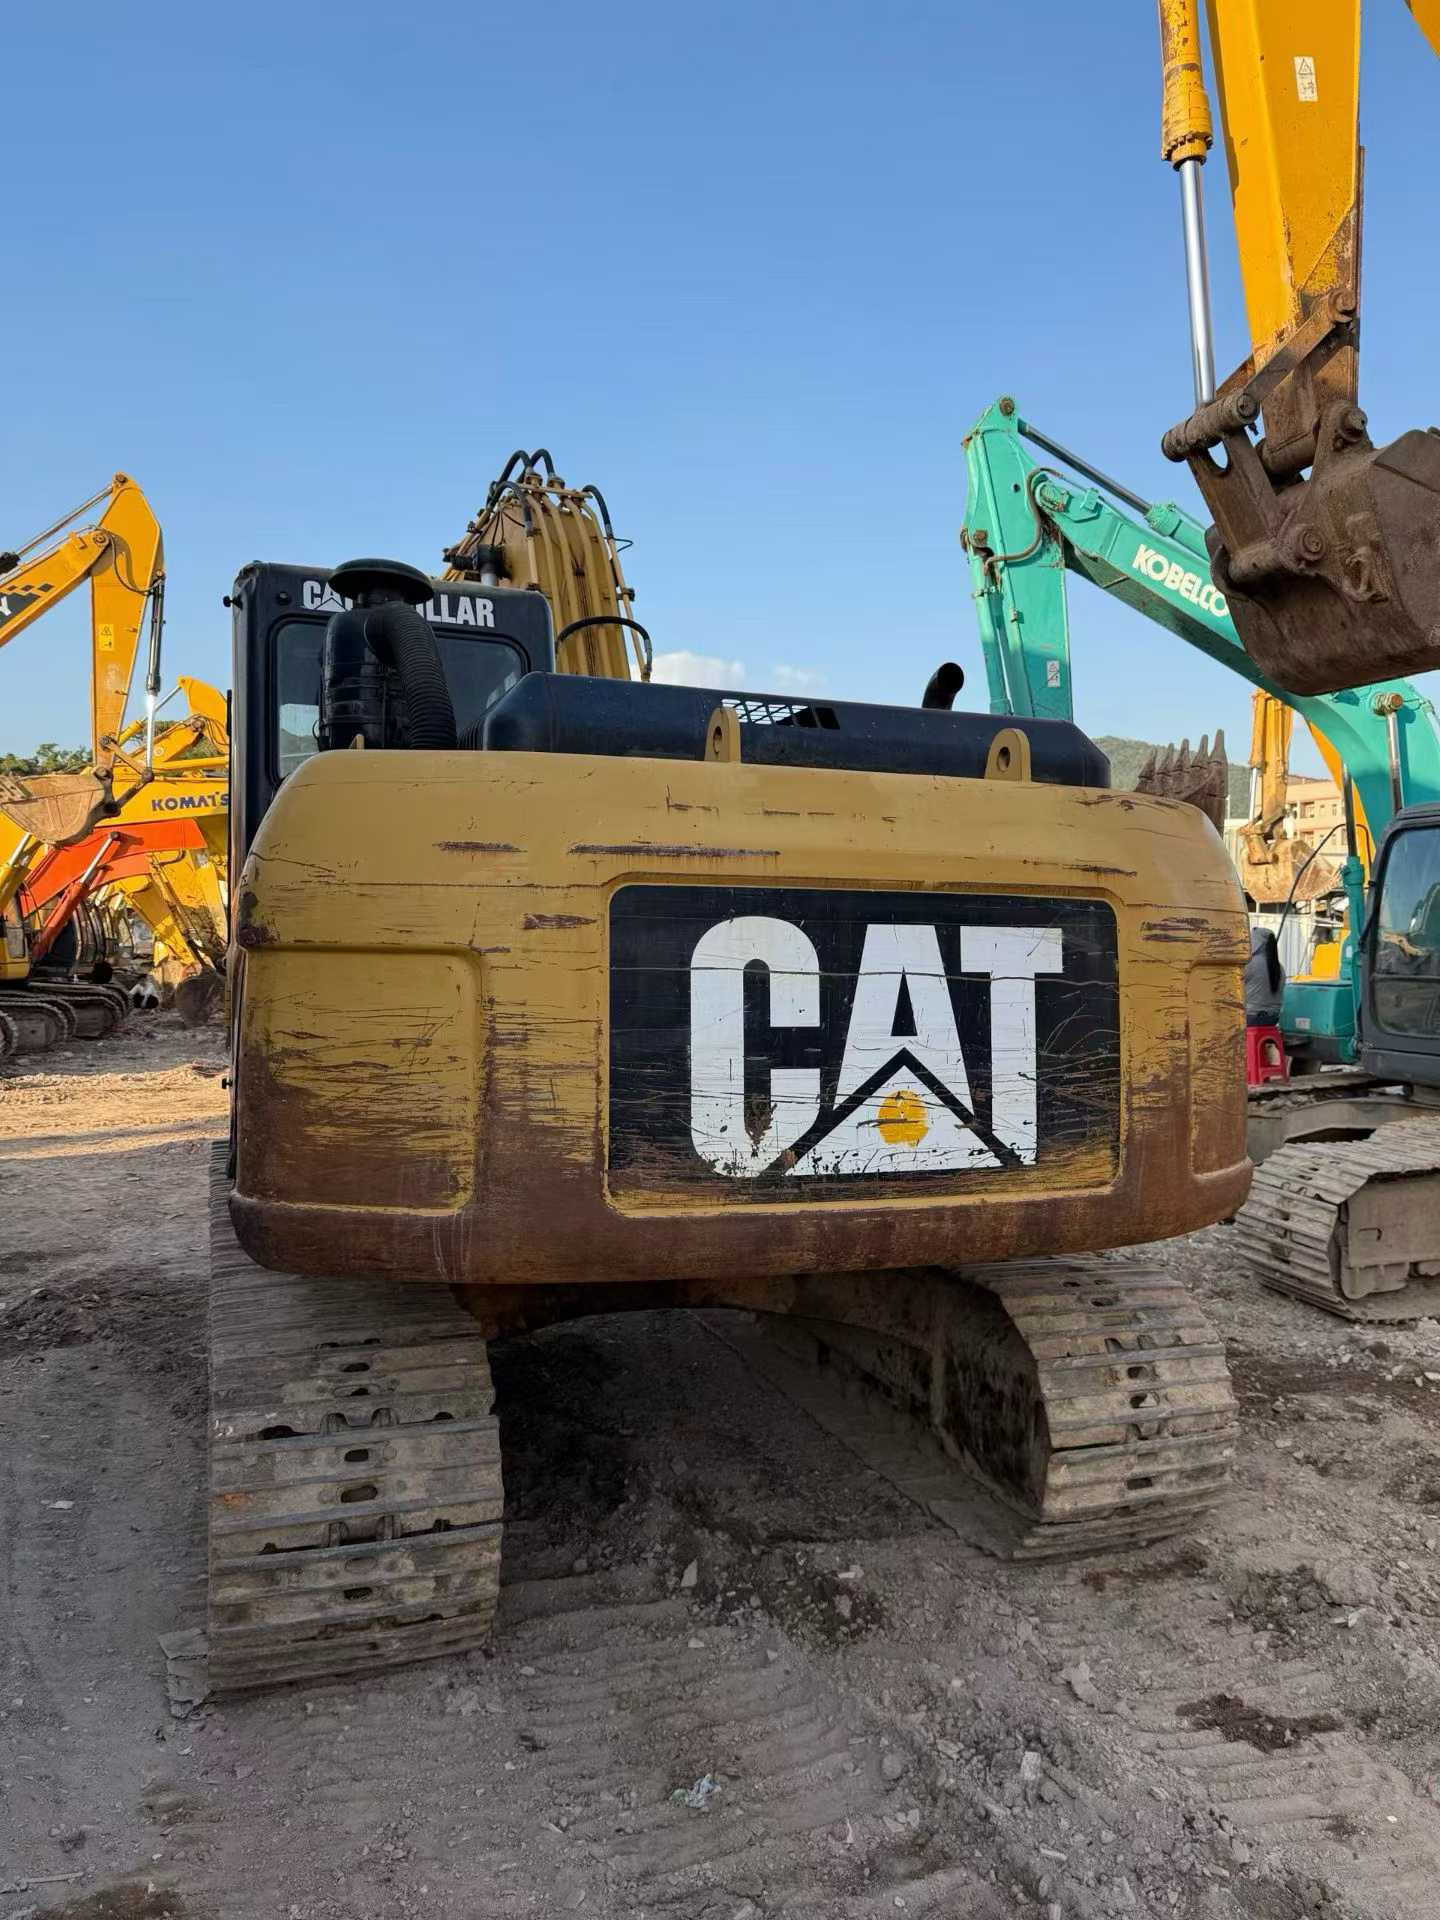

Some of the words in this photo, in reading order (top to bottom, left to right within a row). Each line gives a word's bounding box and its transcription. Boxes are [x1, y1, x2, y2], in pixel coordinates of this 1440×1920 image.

[1132, 544, 1230, 617] KOBELCO
[152, 792, 229, 811] KOMATS
[690, 916, 1063, 1177] CAT
